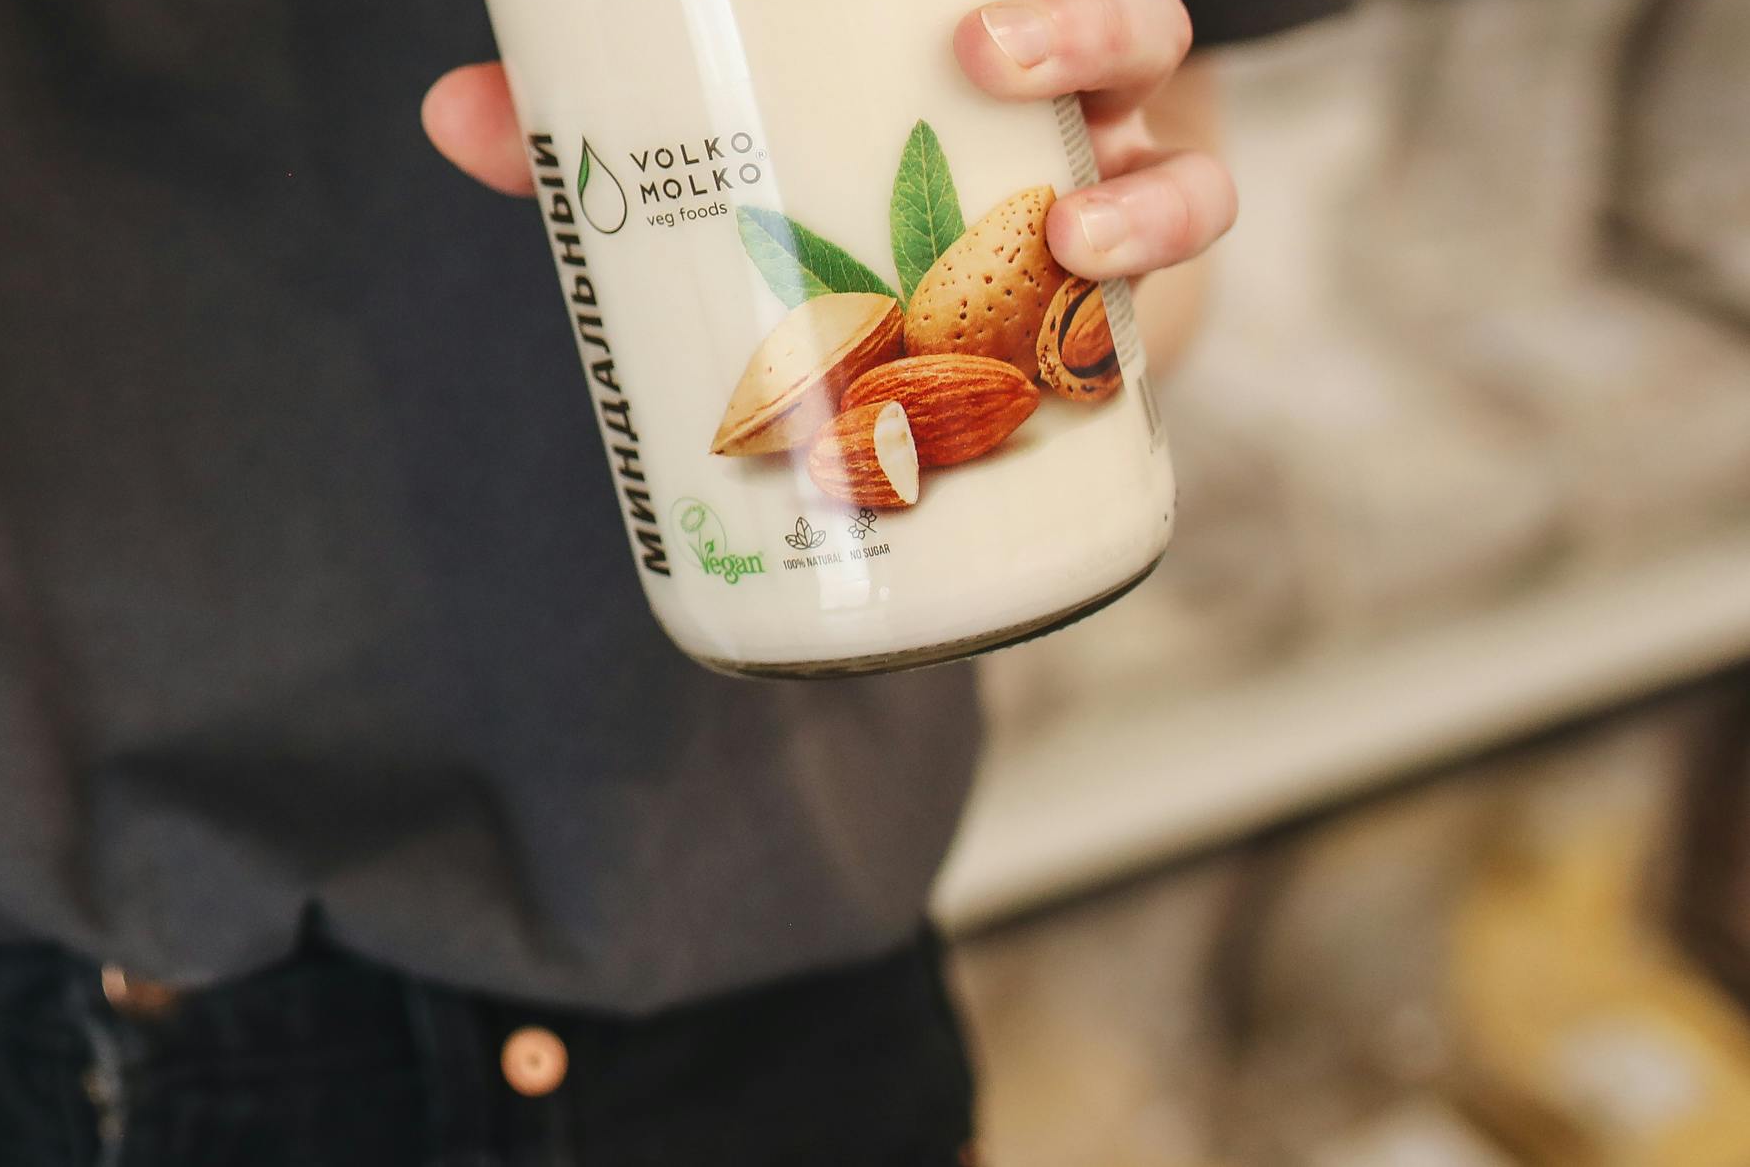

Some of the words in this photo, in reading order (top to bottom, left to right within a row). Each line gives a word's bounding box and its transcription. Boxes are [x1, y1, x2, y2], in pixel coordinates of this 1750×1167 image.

[630, 132, 753, 173] VOLKO
[646, 211, 675, 227] veg
[679, 201, 728, 222] foods
[690, 540, 766, 585] Vegan
[783, 558, 806, 570] 100%
[806, 554, 843, 568] NATURAL
[850, 548, 862, 561] NO
[863, 543, 891, 557] SUGAR
